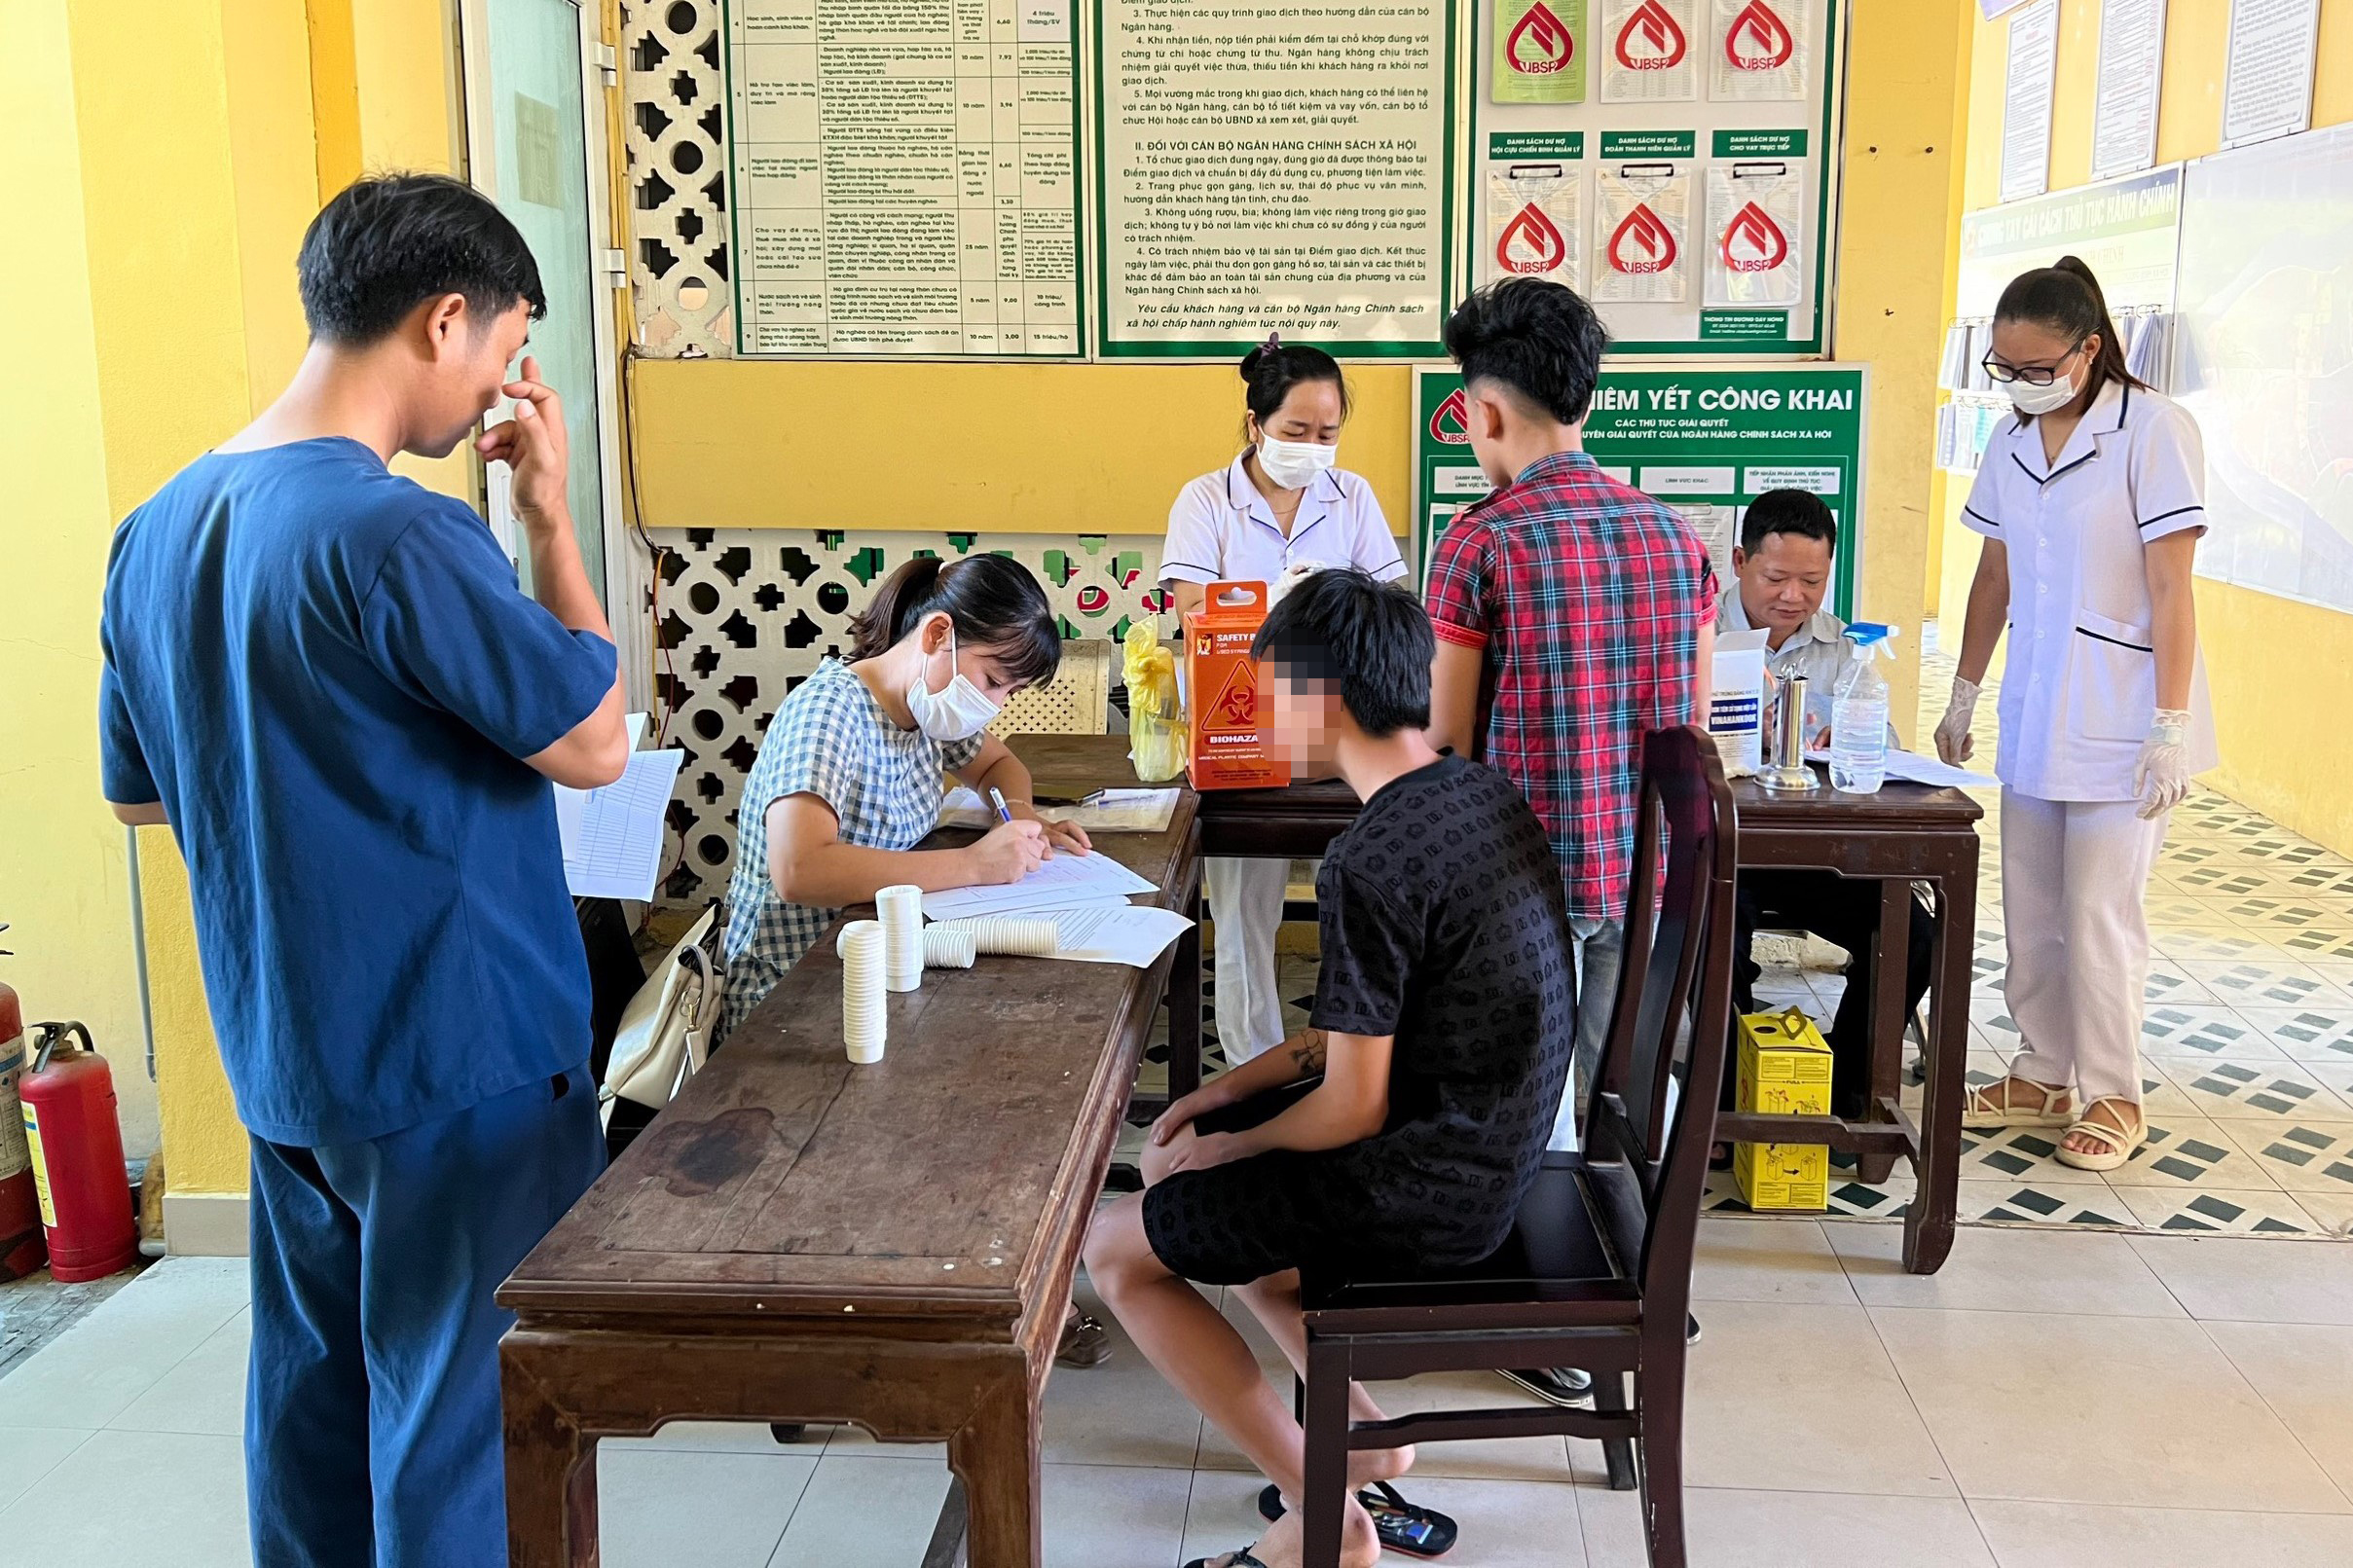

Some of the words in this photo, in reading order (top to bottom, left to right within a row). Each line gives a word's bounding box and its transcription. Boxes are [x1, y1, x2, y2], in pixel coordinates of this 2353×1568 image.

[1225, 115, 1254, 125] UBND
[1268, 116, 1289, 125] xem
[1134, 141, 1144, 151] II.
[1146, 138, 1166, 151] ĐỐI
[1169, 140, 1189, 151] VỚI
[1191, 139, 1215, 151] CÁN
[1217, 139, 1234, 152] BỘ
[1236, 139, 1269, 151] NGÂN
[1271, 139, 1305, 151] HÀNG
[1306, 139, 1342, 150] CHÍNH
[1344, 139, 1376, 150] SÁCH
[1379, 138, 1394, 150] XÃ
[1396, 138, 1416, 151] HỘI
[1134, 181, 1144, 190] 2.
[1147, 181, 1175, 193] Trang
[1400, 181, 1426, 190] minh,
[2107, 190, 2138, 223] HÀNH
[2140, 181, 2176, 217] CHÍNH
[1137, 303, 1158, 313] Yêu
[1159, 303, 1180, 313] cầu
[1182, 304, 1214, 313] khách
[1217, 304, 1245, 315] hàng
[1247, 304, 1261, 313] và
[1263, 304, 1283, 313] cán
[1286, 304, 1301, 314] bộ
[1303, 303, 1331, 315] Ngân
[1334, 303, 1361, 315] hàng
[1364, 303, 1396, 312] Chính
[1398, 304, 1424, 313] sách
[1296, 320, 1317, 330] quy
[1647, 384, 1691, 410] YẾT
[1698, 386, 1781, 410] CÔNG
[1787, 388, 1853, 410] KHAI
[1216, 634, 1248, 642] SAFETY
[1209, 734, 1259, 745] BIOHAZA
